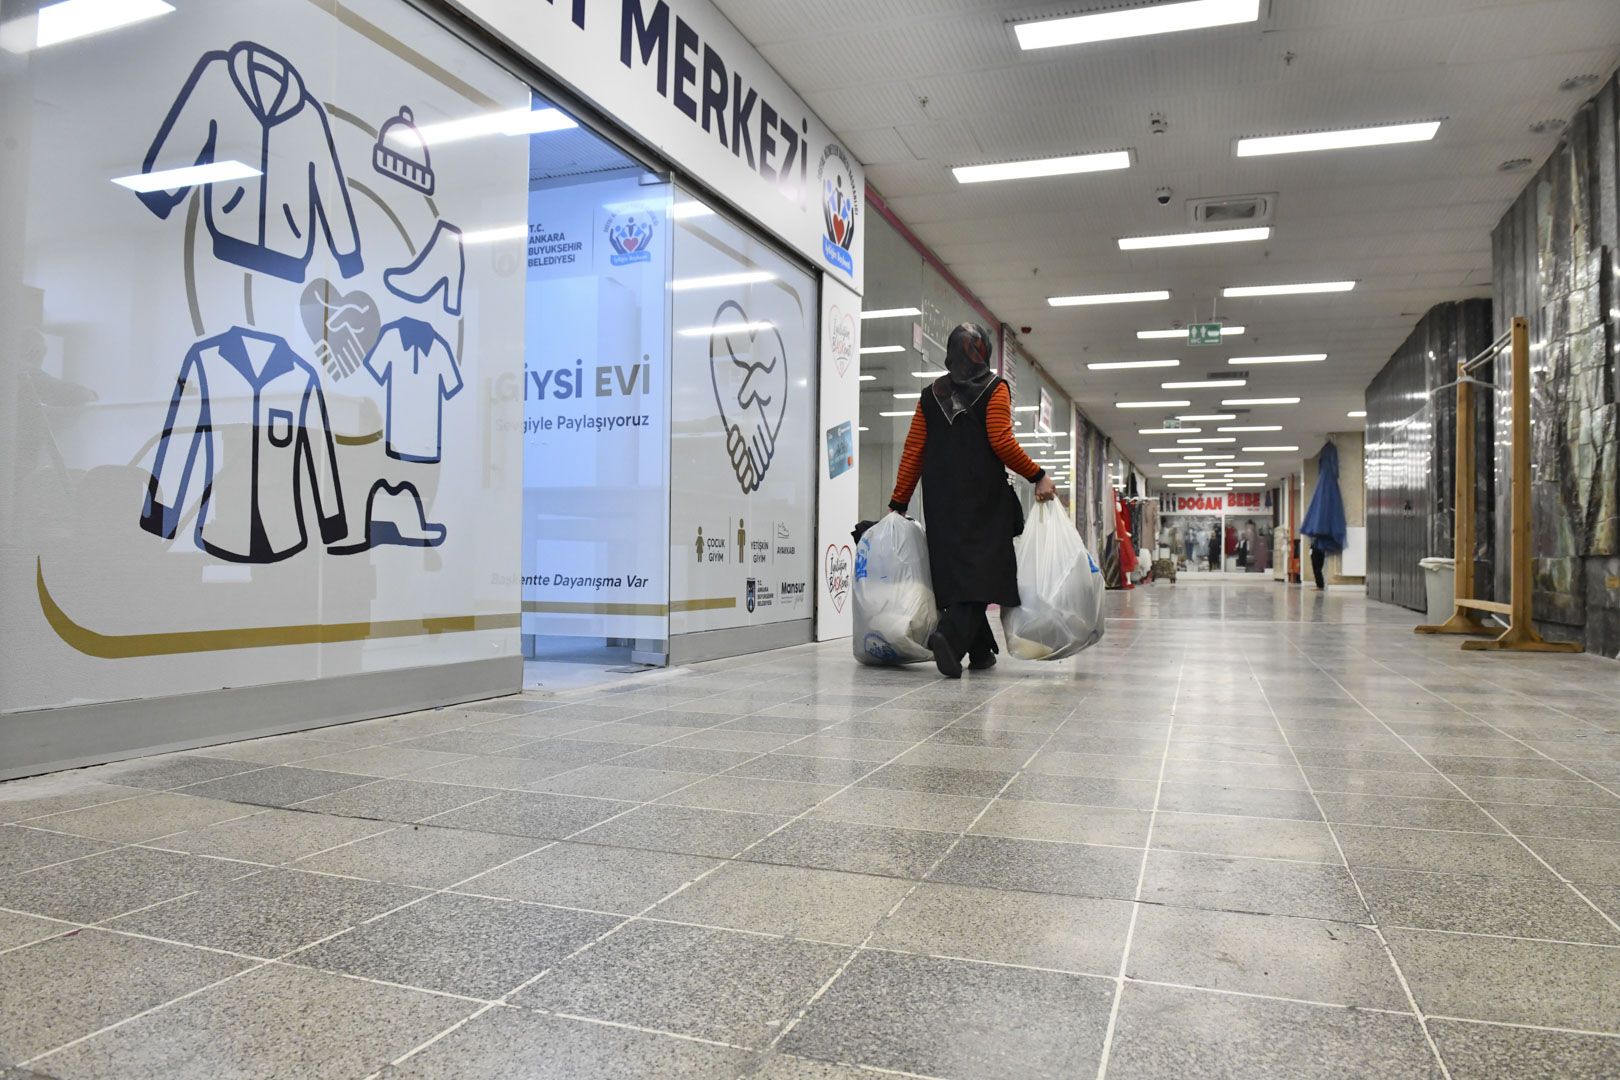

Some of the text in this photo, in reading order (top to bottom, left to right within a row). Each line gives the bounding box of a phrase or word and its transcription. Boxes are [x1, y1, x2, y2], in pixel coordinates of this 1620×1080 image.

[620, 0, 809, 212] MERKEZİ
[529, 224, 544, 233] T.C.
[529, 233, 565, 245] ANKARA
[596, 354, 650, 397] EVİ
[557, 414, 649, 432] Paylaşıyoruz
[554, 573, 622, 590] Dayanışma
[626, 575, 648, 588] Var
[781, 582, 805, 594] Mansur
